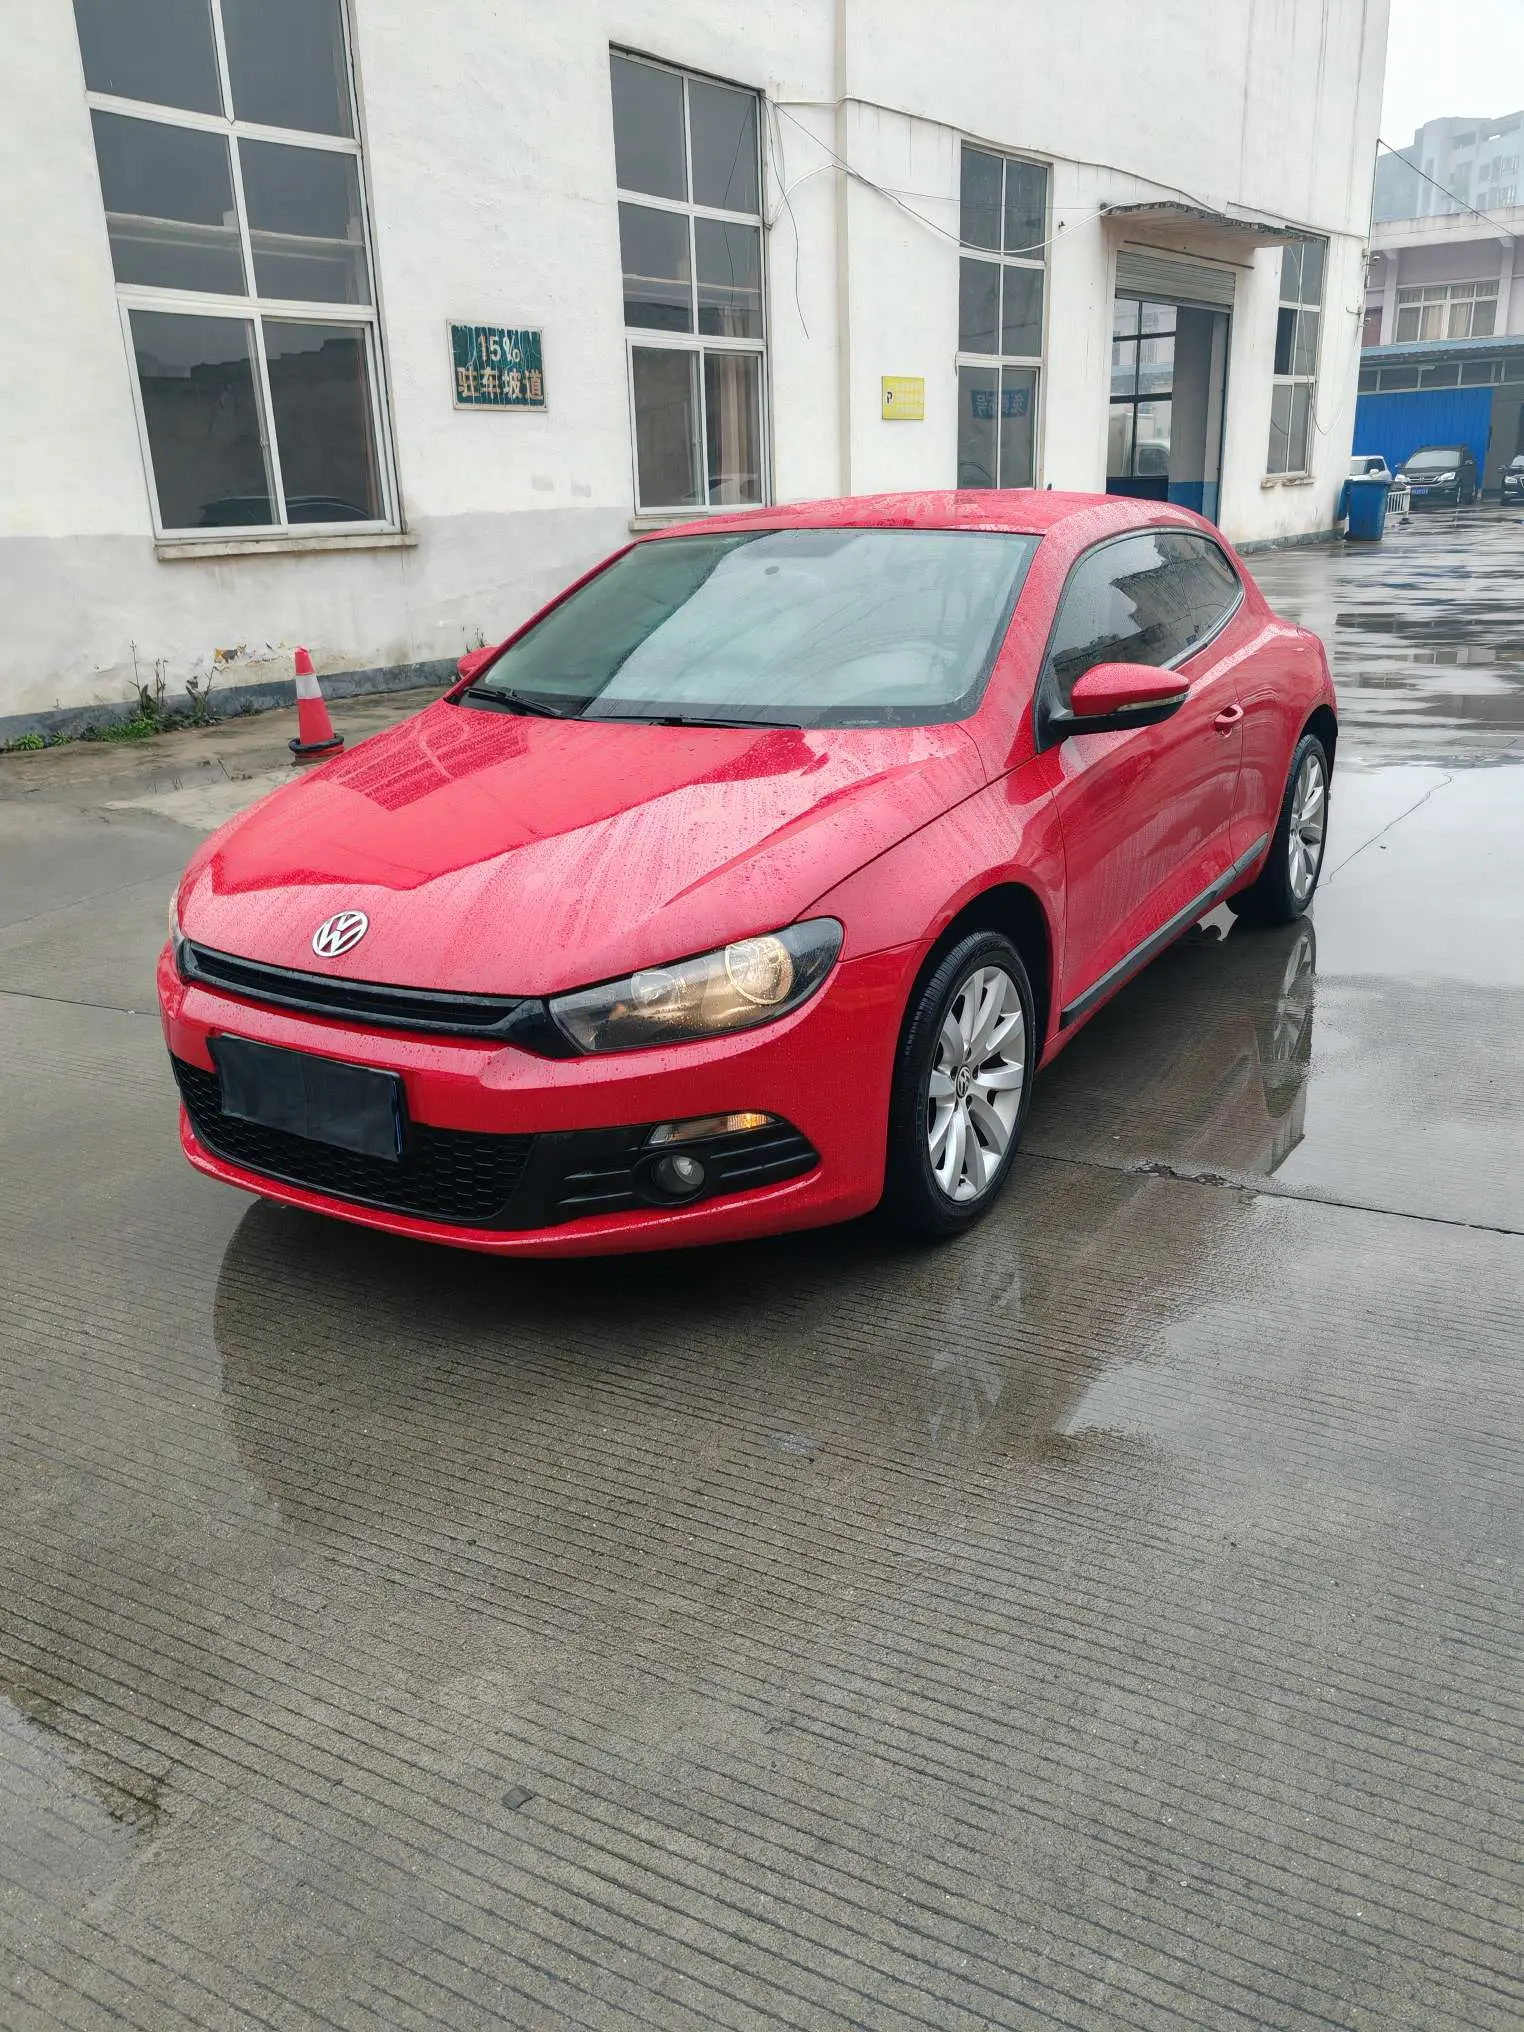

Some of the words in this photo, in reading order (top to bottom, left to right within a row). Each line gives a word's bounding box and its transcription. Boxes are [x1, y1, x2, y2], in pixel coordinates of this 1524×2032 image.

[478, 335, 521, 362] 15%
[456, 367, 544, 400] 驻车坡道
